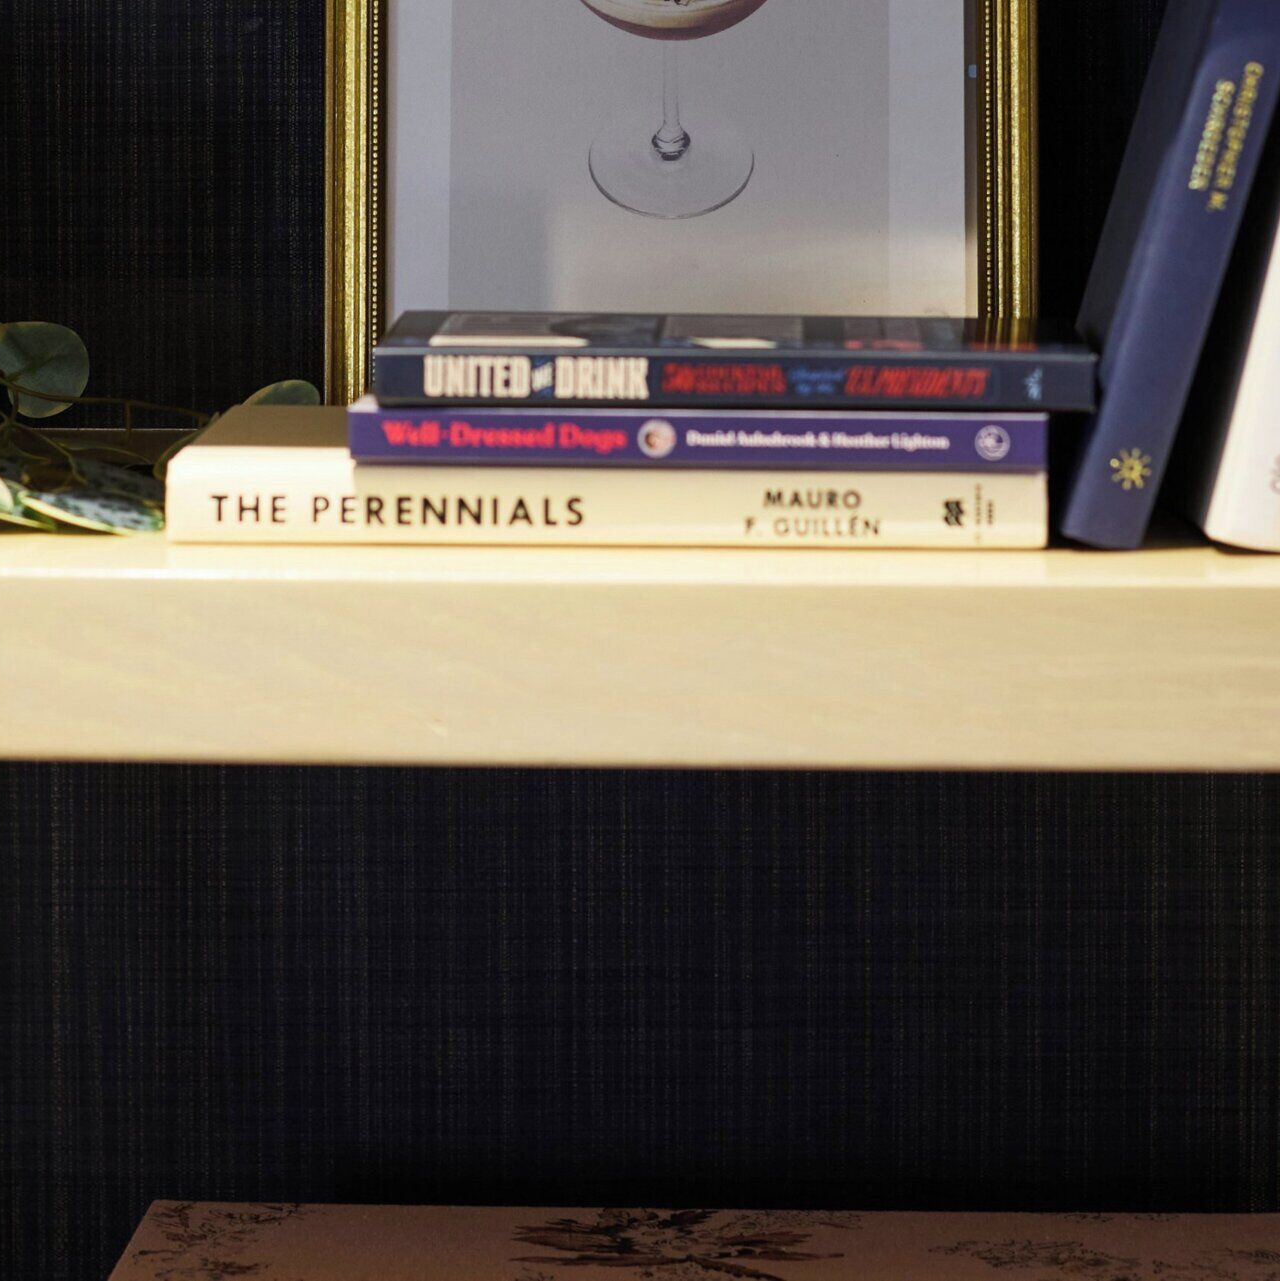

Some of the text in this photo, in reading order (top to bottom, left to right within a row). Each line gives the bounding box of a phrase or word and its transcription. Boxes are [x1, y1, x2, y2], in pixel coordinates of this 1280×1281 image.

[1212, 59, 1266, 191] CHRISTOPHER
[423, 354, 531, 398] UNITED
[554, 356, 650, 400] DRINK
[381, 420, 628, 454] Well-Dressed Dogs
[211, 494, 585, 526] THE PERENNIALS
[763, 489, 862, 510] MAURO
[745, 515, 881, 537] F. GUILLÉN
